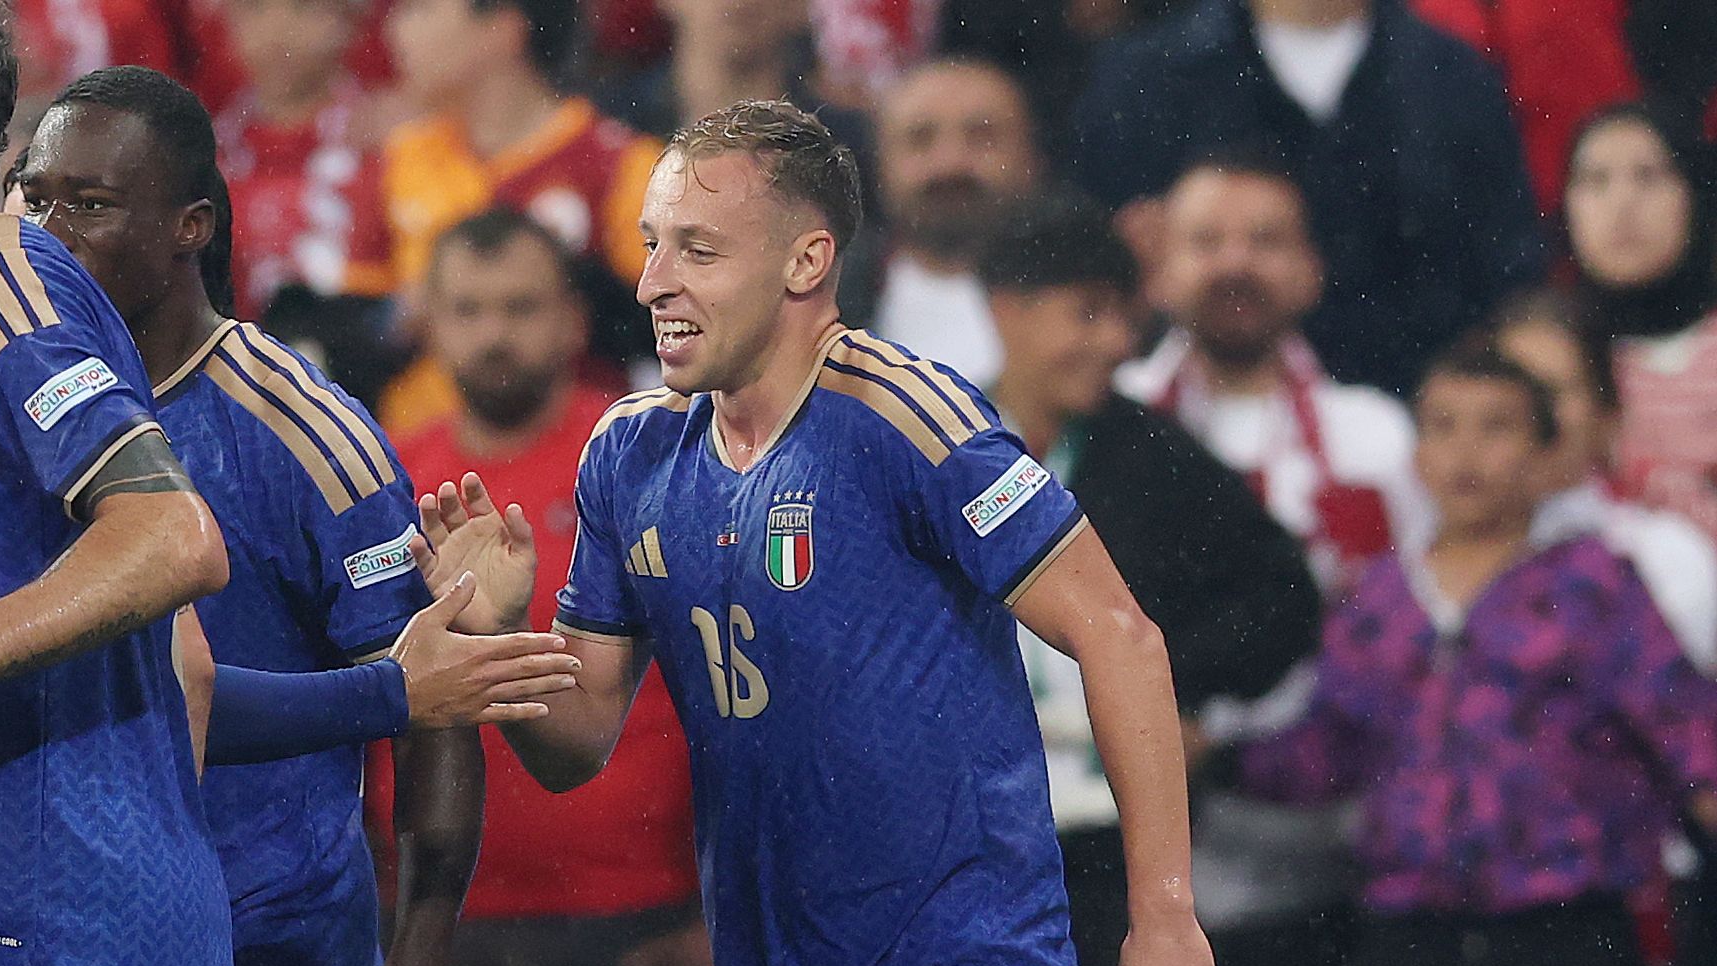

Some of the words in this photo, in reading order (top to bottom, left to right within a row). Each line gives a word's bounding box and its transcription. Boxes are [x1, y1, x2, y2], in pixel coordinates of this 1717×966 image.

[32, 364, 109, 421] FOUNDATION
[969, 463, 1041, 527] FOUNDATION
[770, 511, 809, 529] ITALIA
[346, 553, 369, 568] UEFA
[348, 543, 413, 579] FOUNDA
[690, 603, 770, 719] 16
